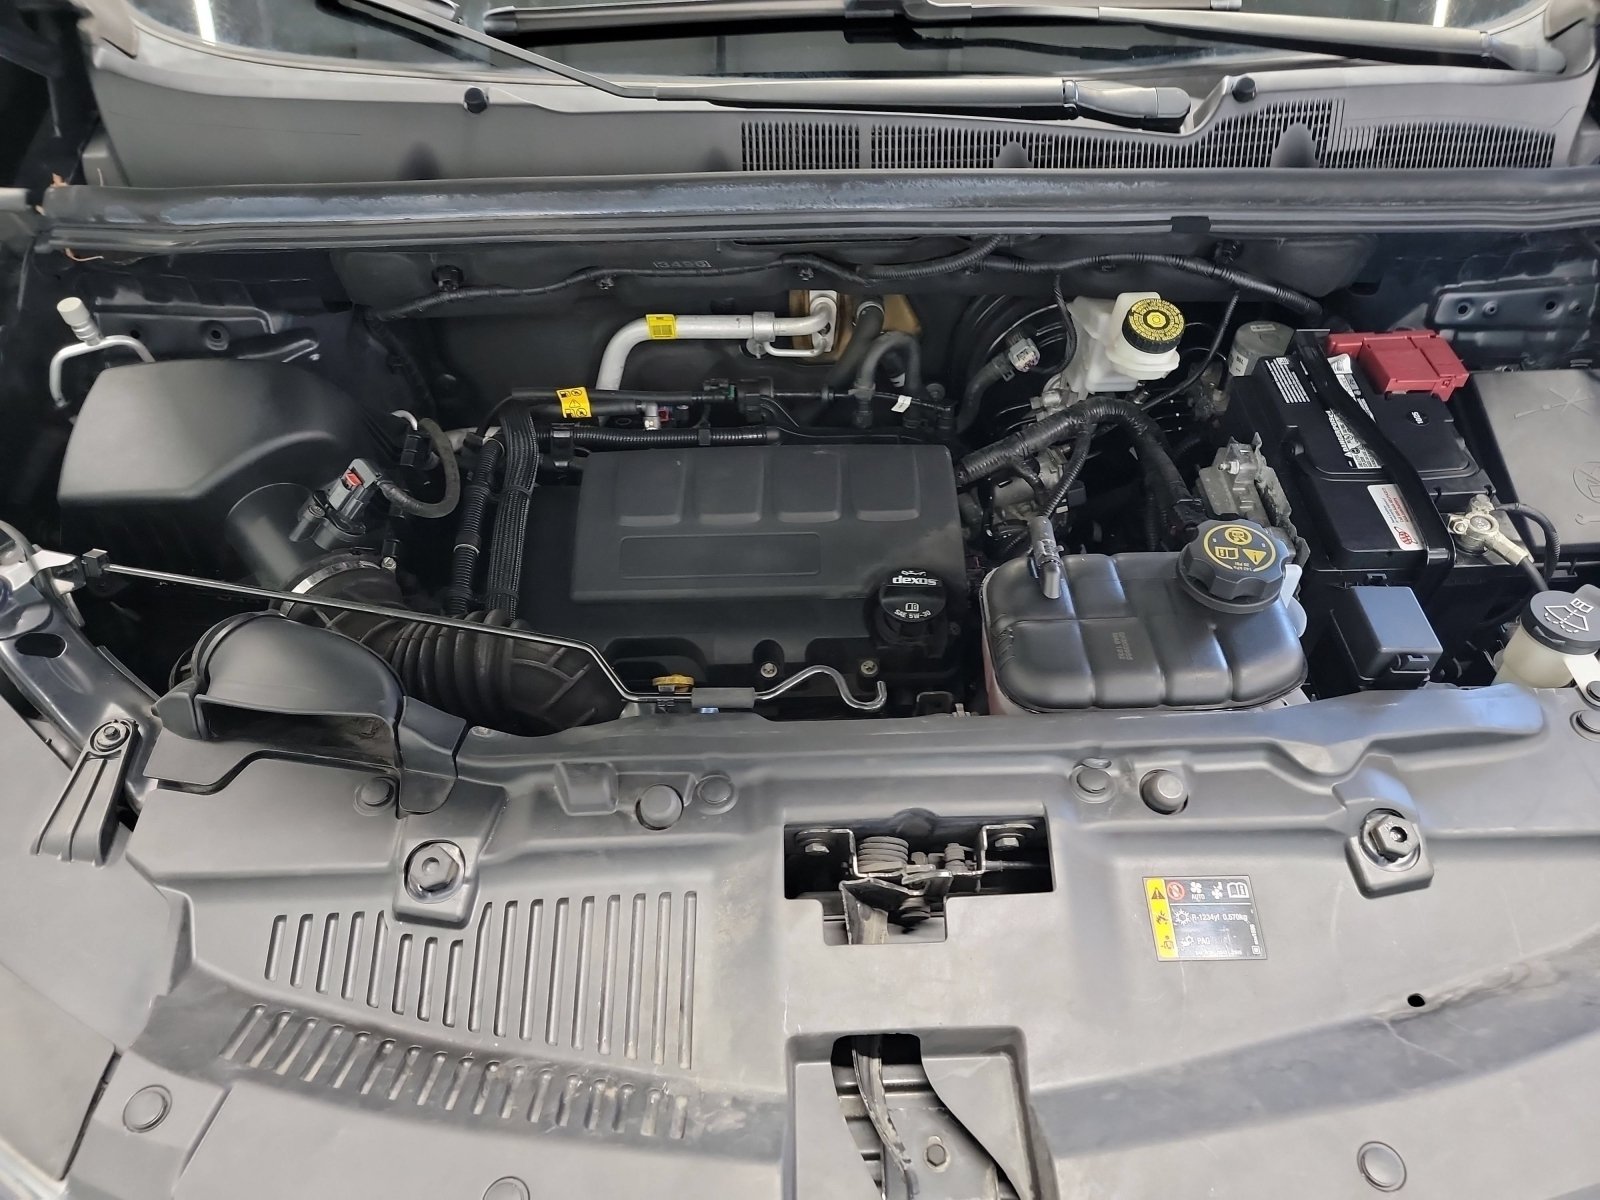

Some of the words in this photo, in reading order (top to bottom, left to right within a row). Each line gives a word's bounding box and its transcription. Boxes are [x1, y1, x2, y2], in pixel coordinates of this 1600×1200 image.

[892, 575, 939, 586] dexos
[893, 609, 907, 618] SAE
[908, 610, 931, 619] 5W-30
[1191, 893, 1206, 901] AUTO
